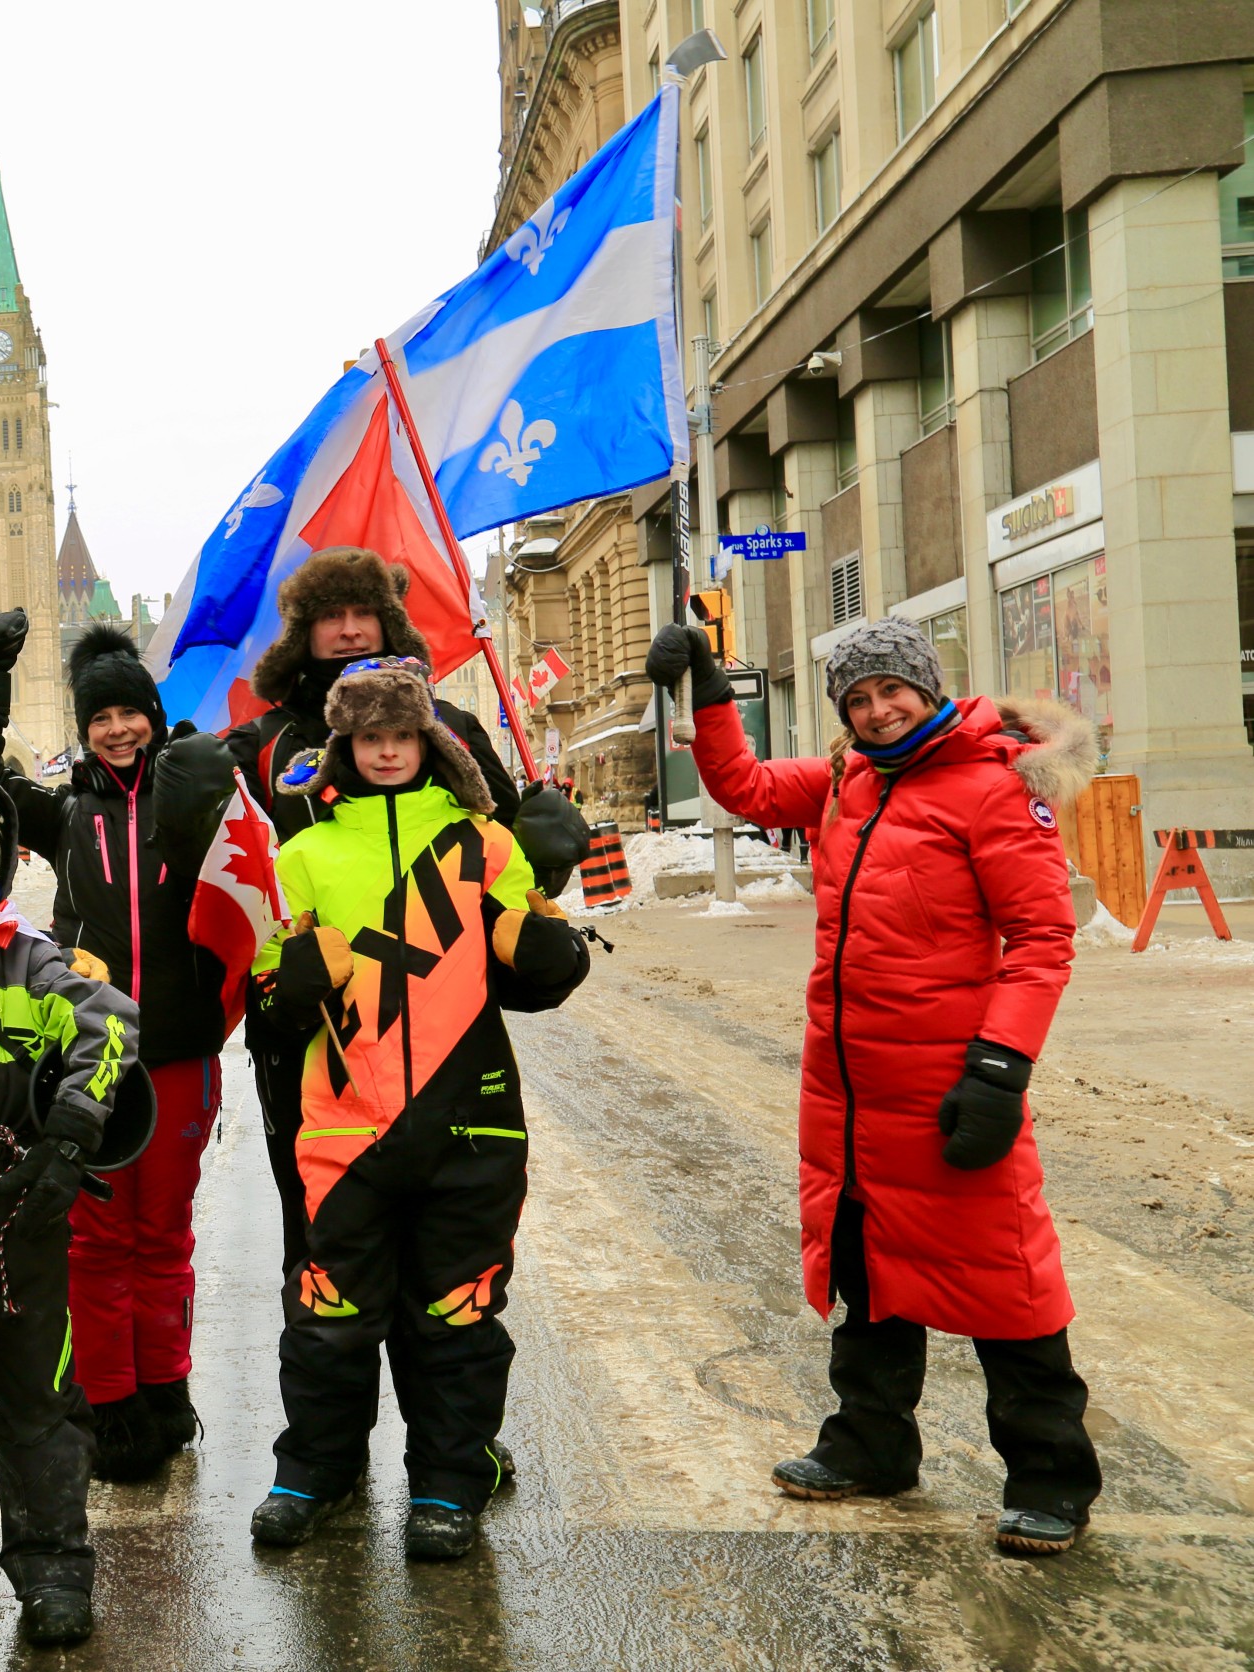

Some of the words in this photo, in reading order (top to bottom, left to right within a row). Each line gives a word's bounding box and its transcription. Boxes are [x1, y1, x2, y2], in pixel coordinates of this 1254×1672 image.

[1002, 488, 1055, 541] swatch
[746, 535, 783, 552] Sparks
[785, 538, 795, 547] St.
